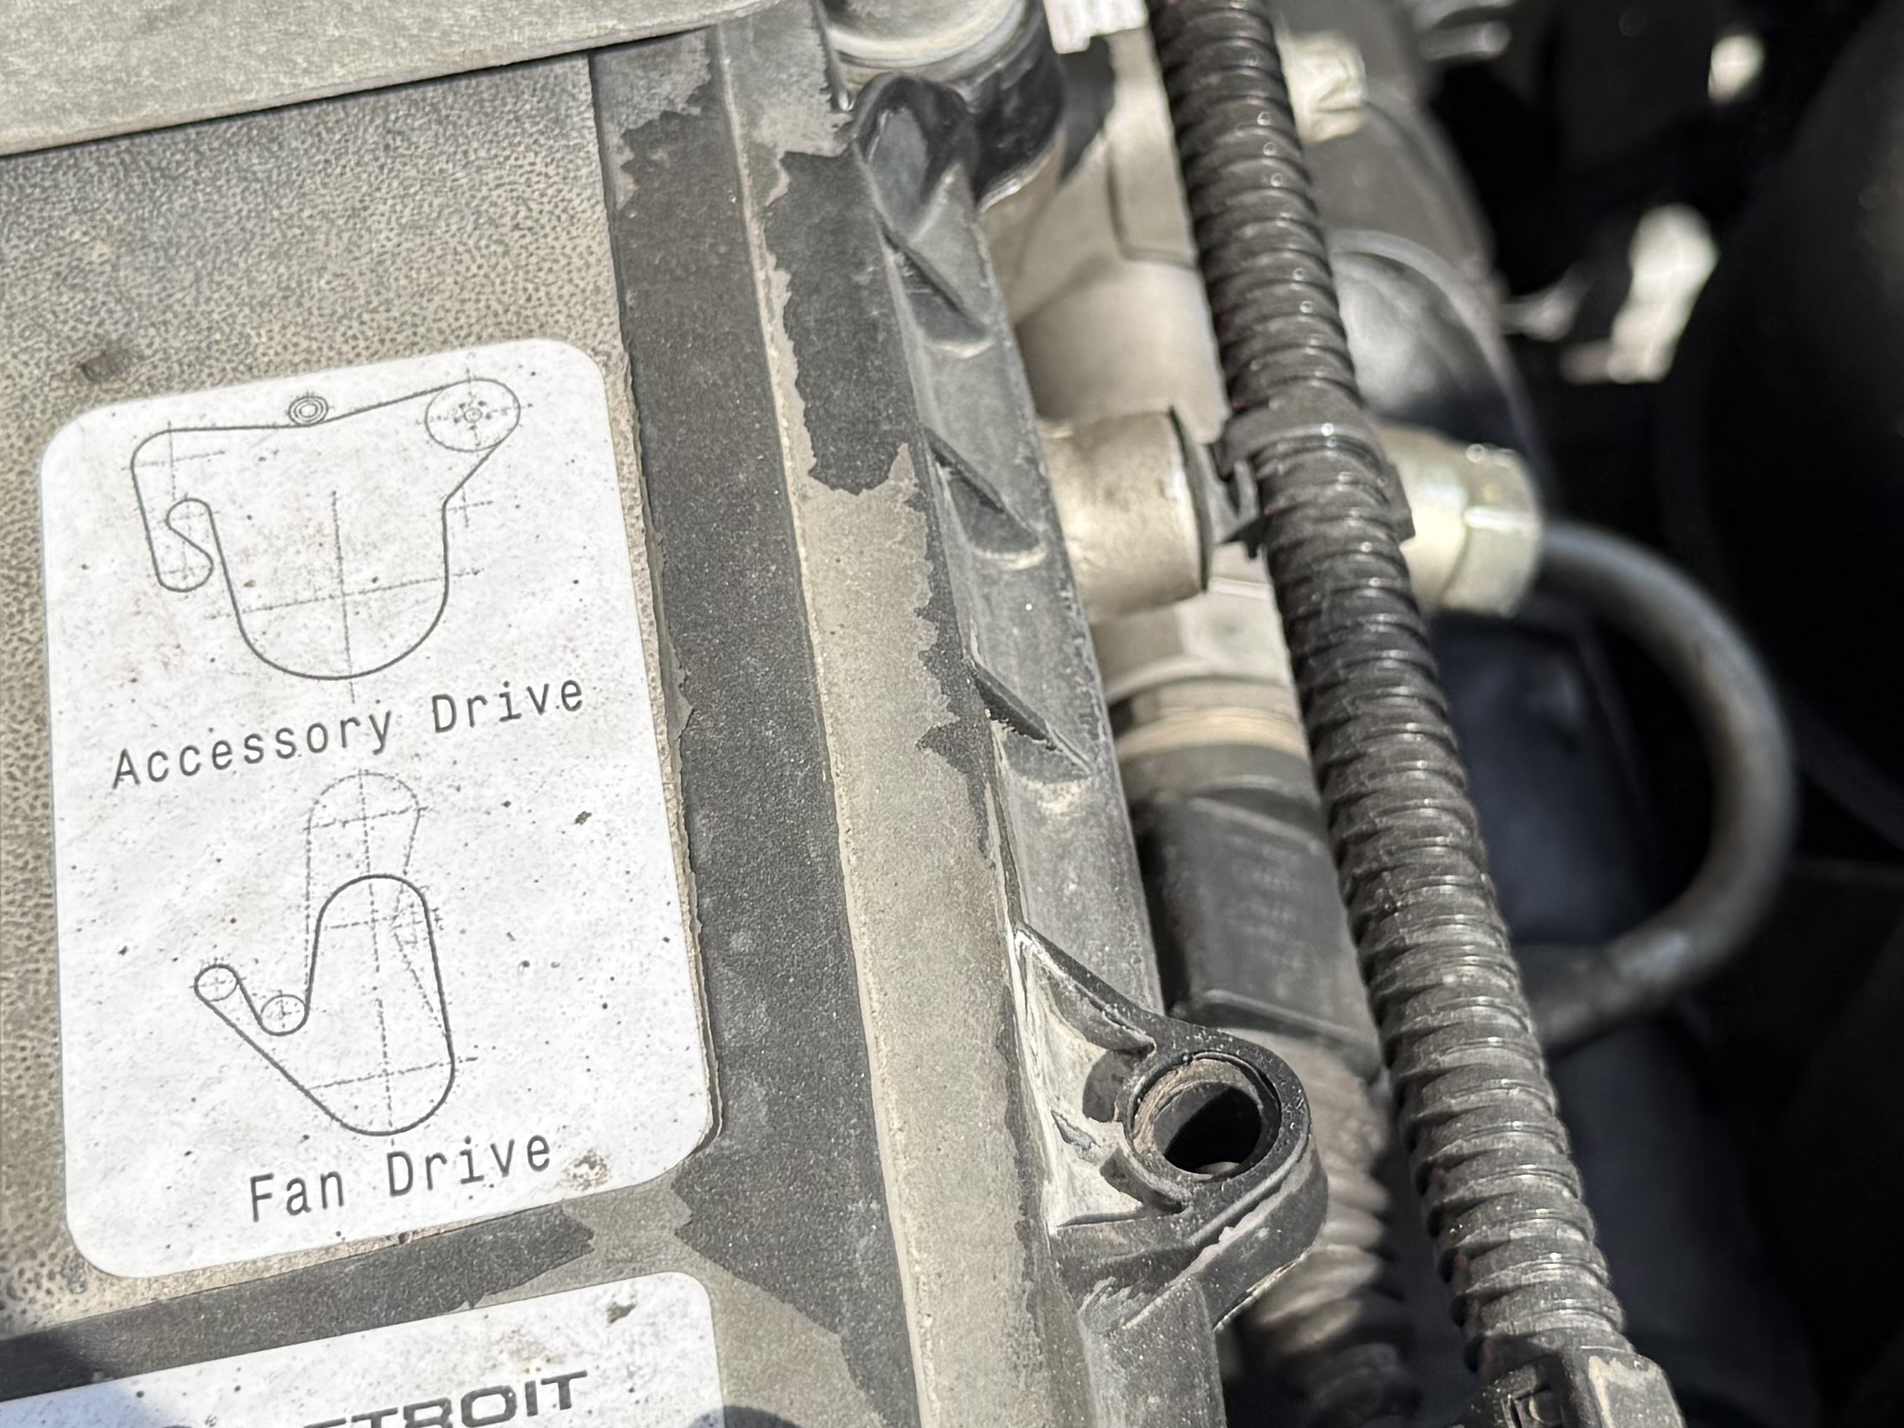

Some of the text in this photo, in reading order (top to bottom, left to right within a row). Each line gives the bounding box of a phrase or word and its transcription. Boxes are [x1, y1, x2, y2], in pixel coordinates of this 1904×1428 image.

[112, 675, 587, 790] Accessory Drive
[248, 1130, 554, 1224] Fan Drive
